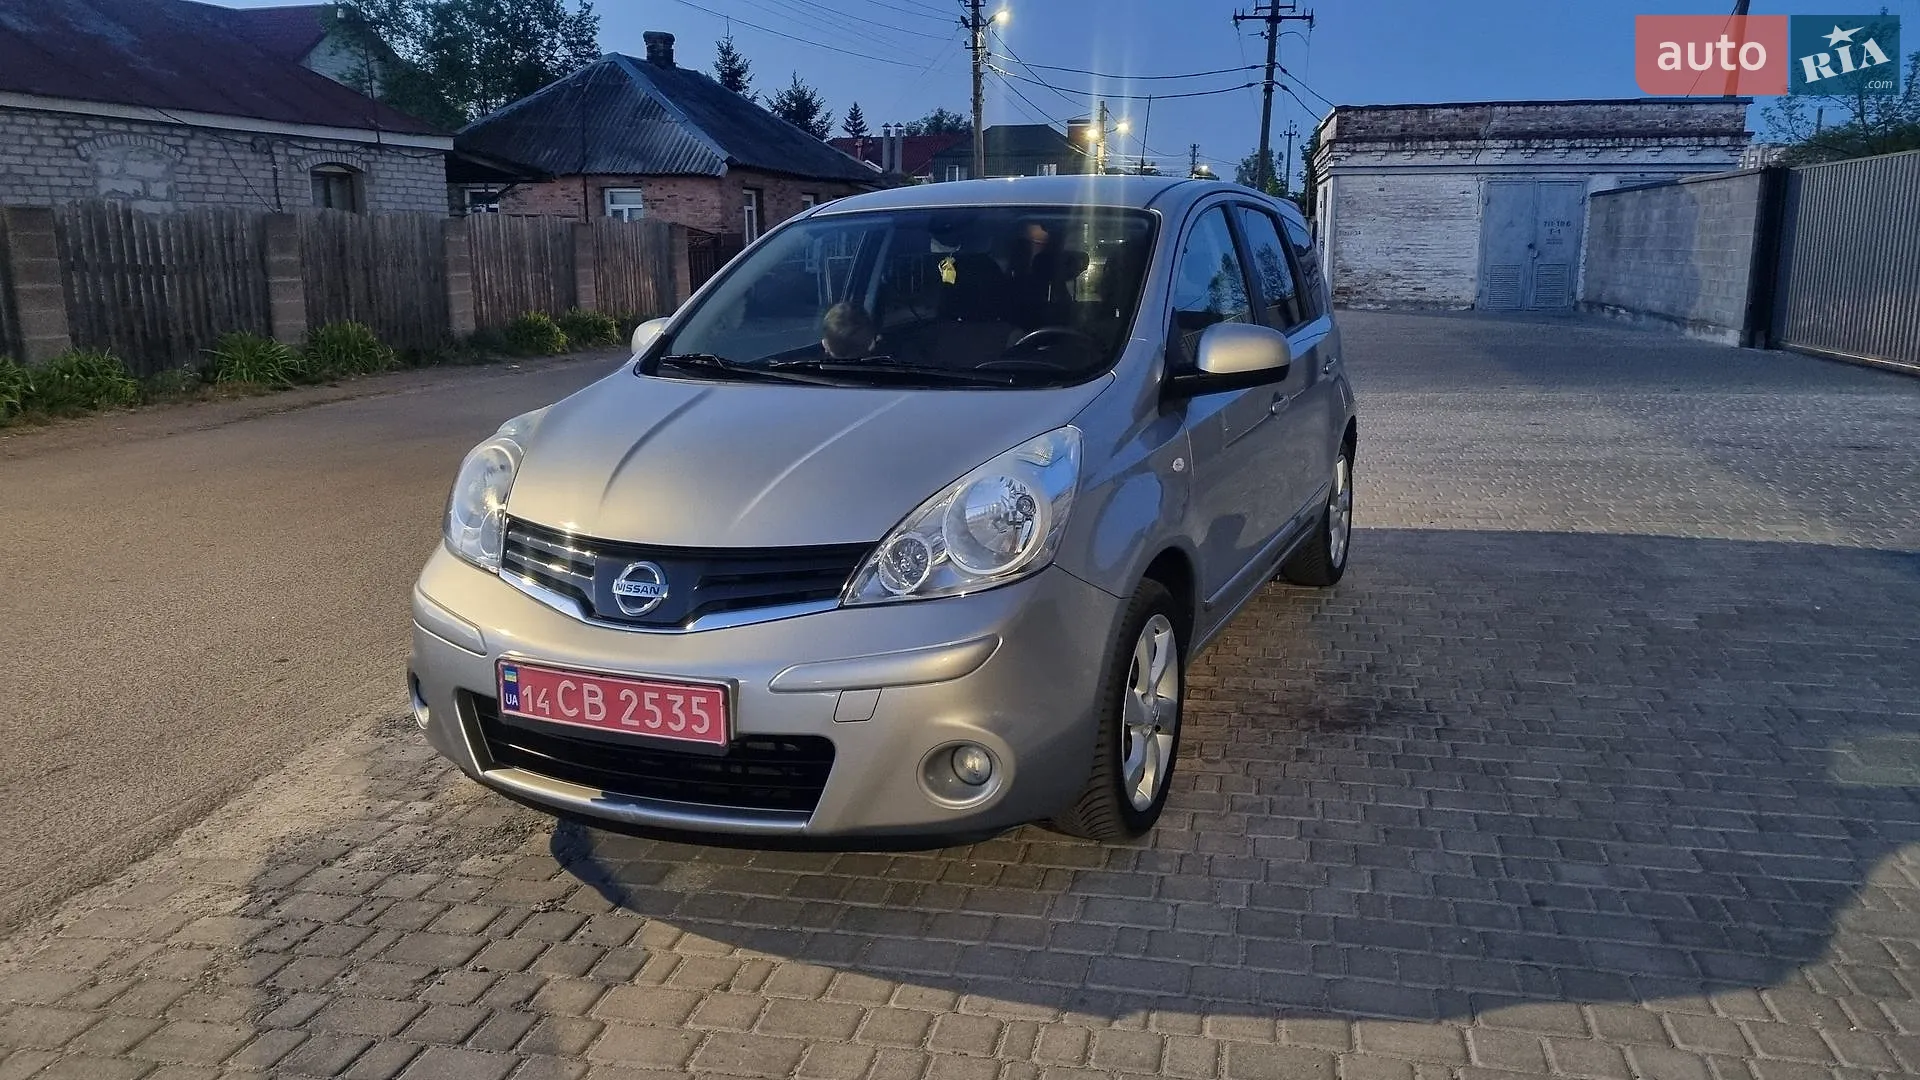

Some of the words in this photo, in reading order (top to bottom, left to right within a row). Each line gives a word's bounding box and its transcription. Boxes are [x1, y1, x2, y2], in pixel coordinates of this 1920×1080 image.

[615, 583, 660, 595] NISSAN
[505, 693, 518, 706] UA
[619, 689, 710, 734] 2535
